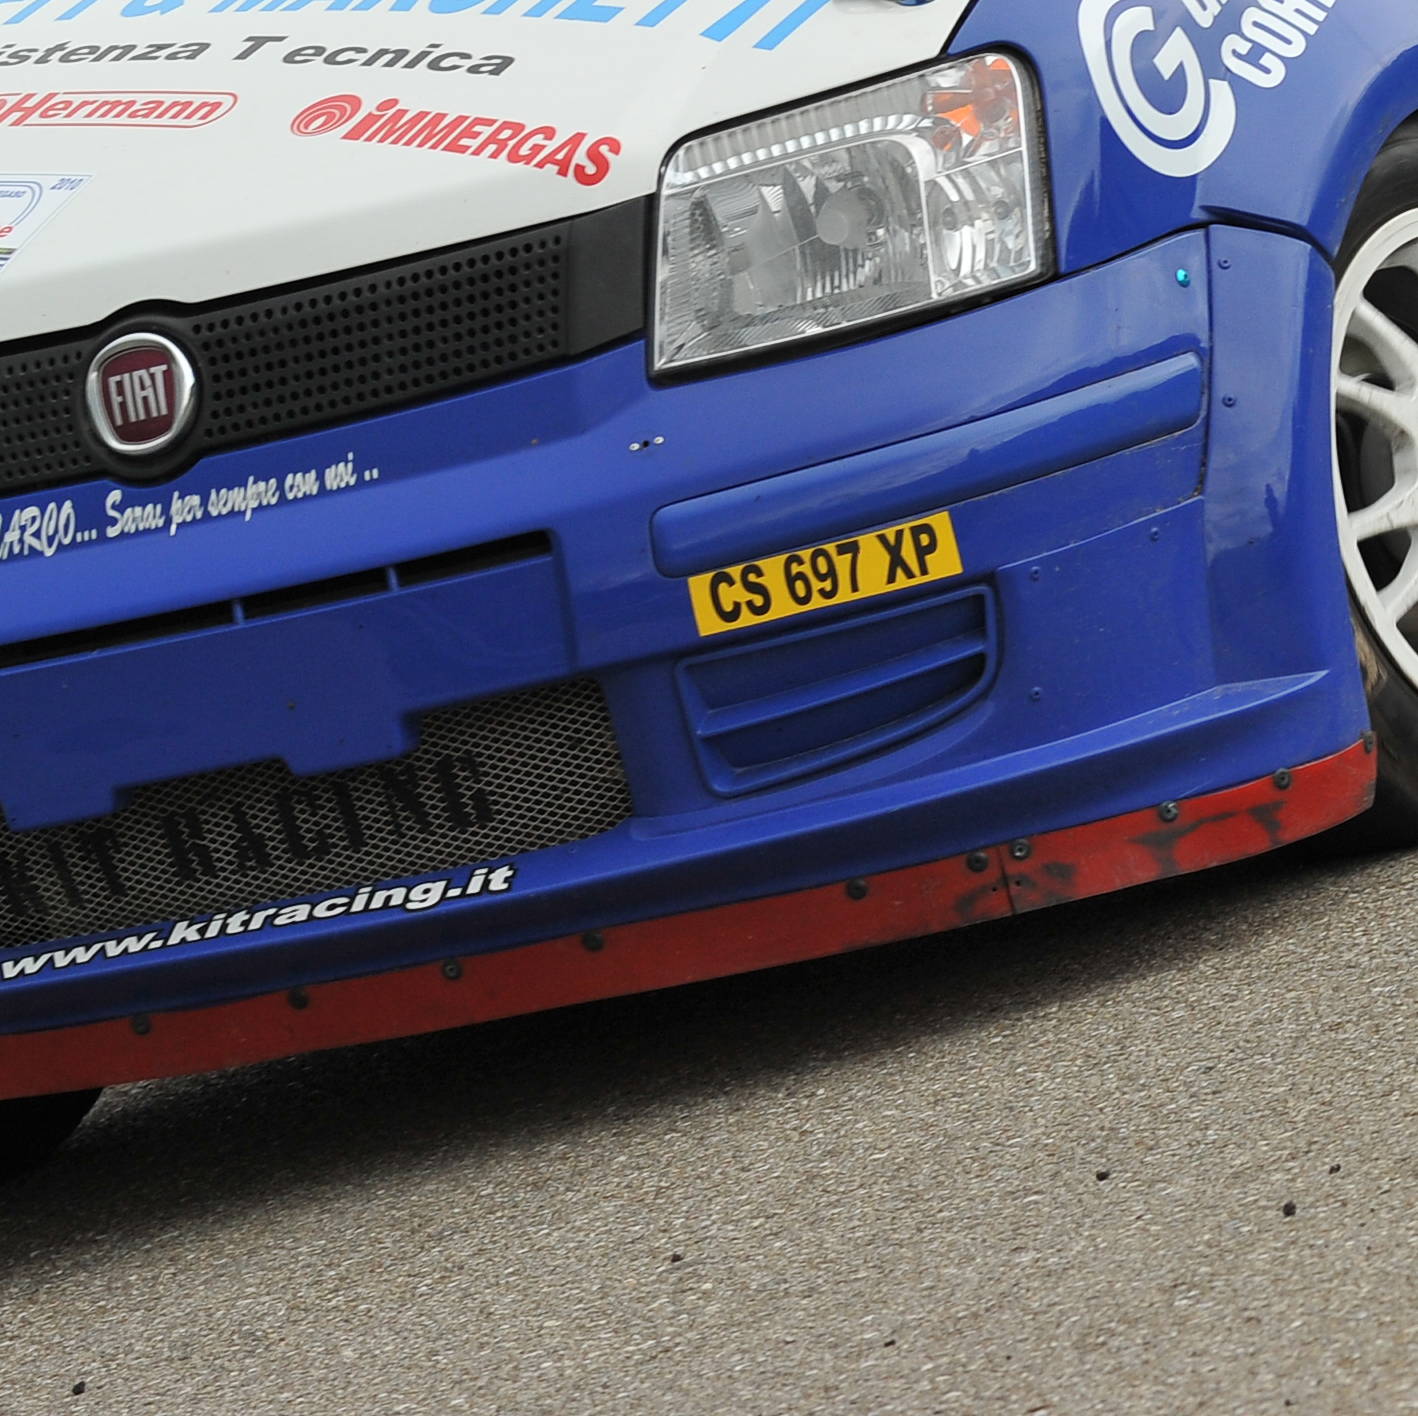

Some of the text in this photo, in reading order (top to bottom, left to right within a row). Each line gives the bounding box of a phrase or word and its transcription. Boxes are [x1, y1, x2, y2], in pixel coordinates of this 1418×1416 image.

[107, 363, 171, 427] FIAT
[170, 491, 204, 536] per
[207, 476, 279, 522] sempre
[284, 468, 320, 501] con
[324, 452, 355, 492] noi
[708, 522, 940, 624] CS 697 XP
[0, 864, 515, 980] www.kitracing.it
